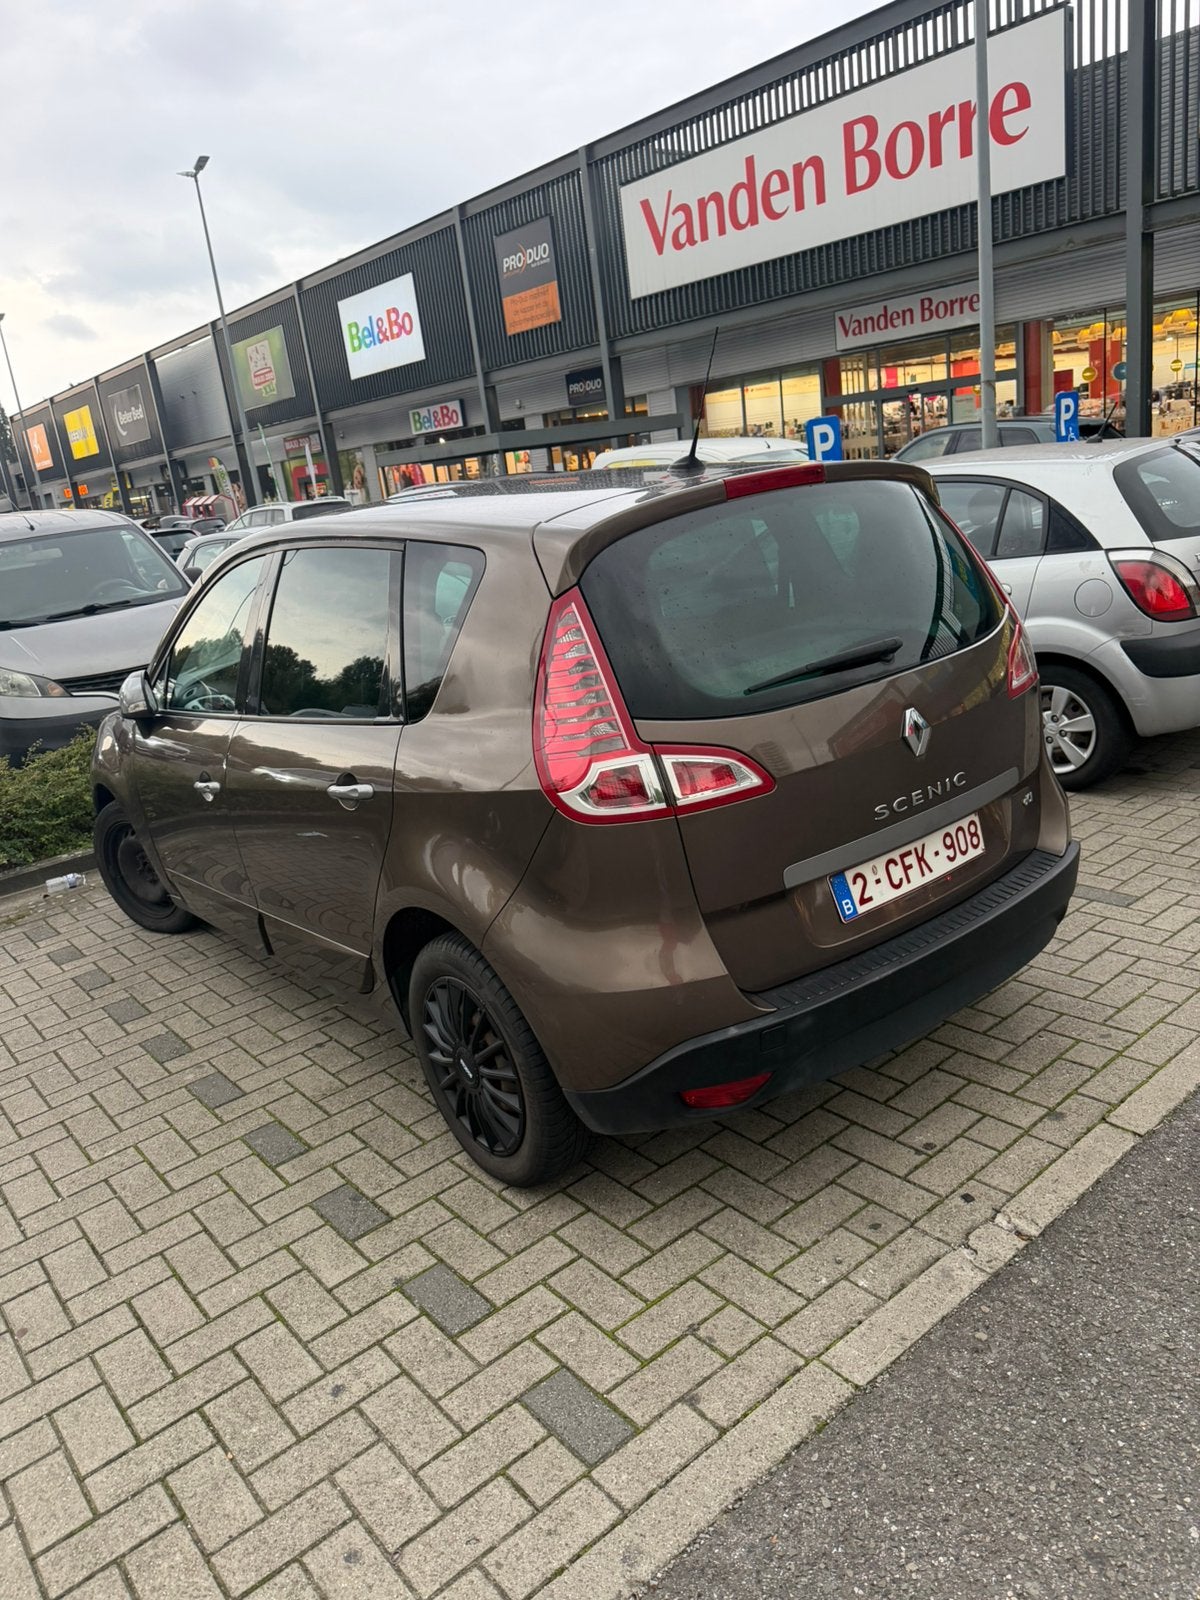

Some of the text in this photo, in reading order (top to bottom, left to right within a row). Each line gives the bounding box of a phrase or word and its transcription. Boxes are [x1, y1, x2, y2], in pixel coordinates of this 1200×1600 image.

[640, 81, 1031, 256] Vanden Borre
[347, 307, 413, 352] Bel&Bo
[838, 293, 980, 338] Vanden Borre
[412, 405, 459, 432] Bel&Bo
[1060, 398, 1075, 436] P
[813, 424, 835, 461] P
[874, 771, 967, 821] SCENIC
[842, 819, 981, 915] B 2-CFK-908
